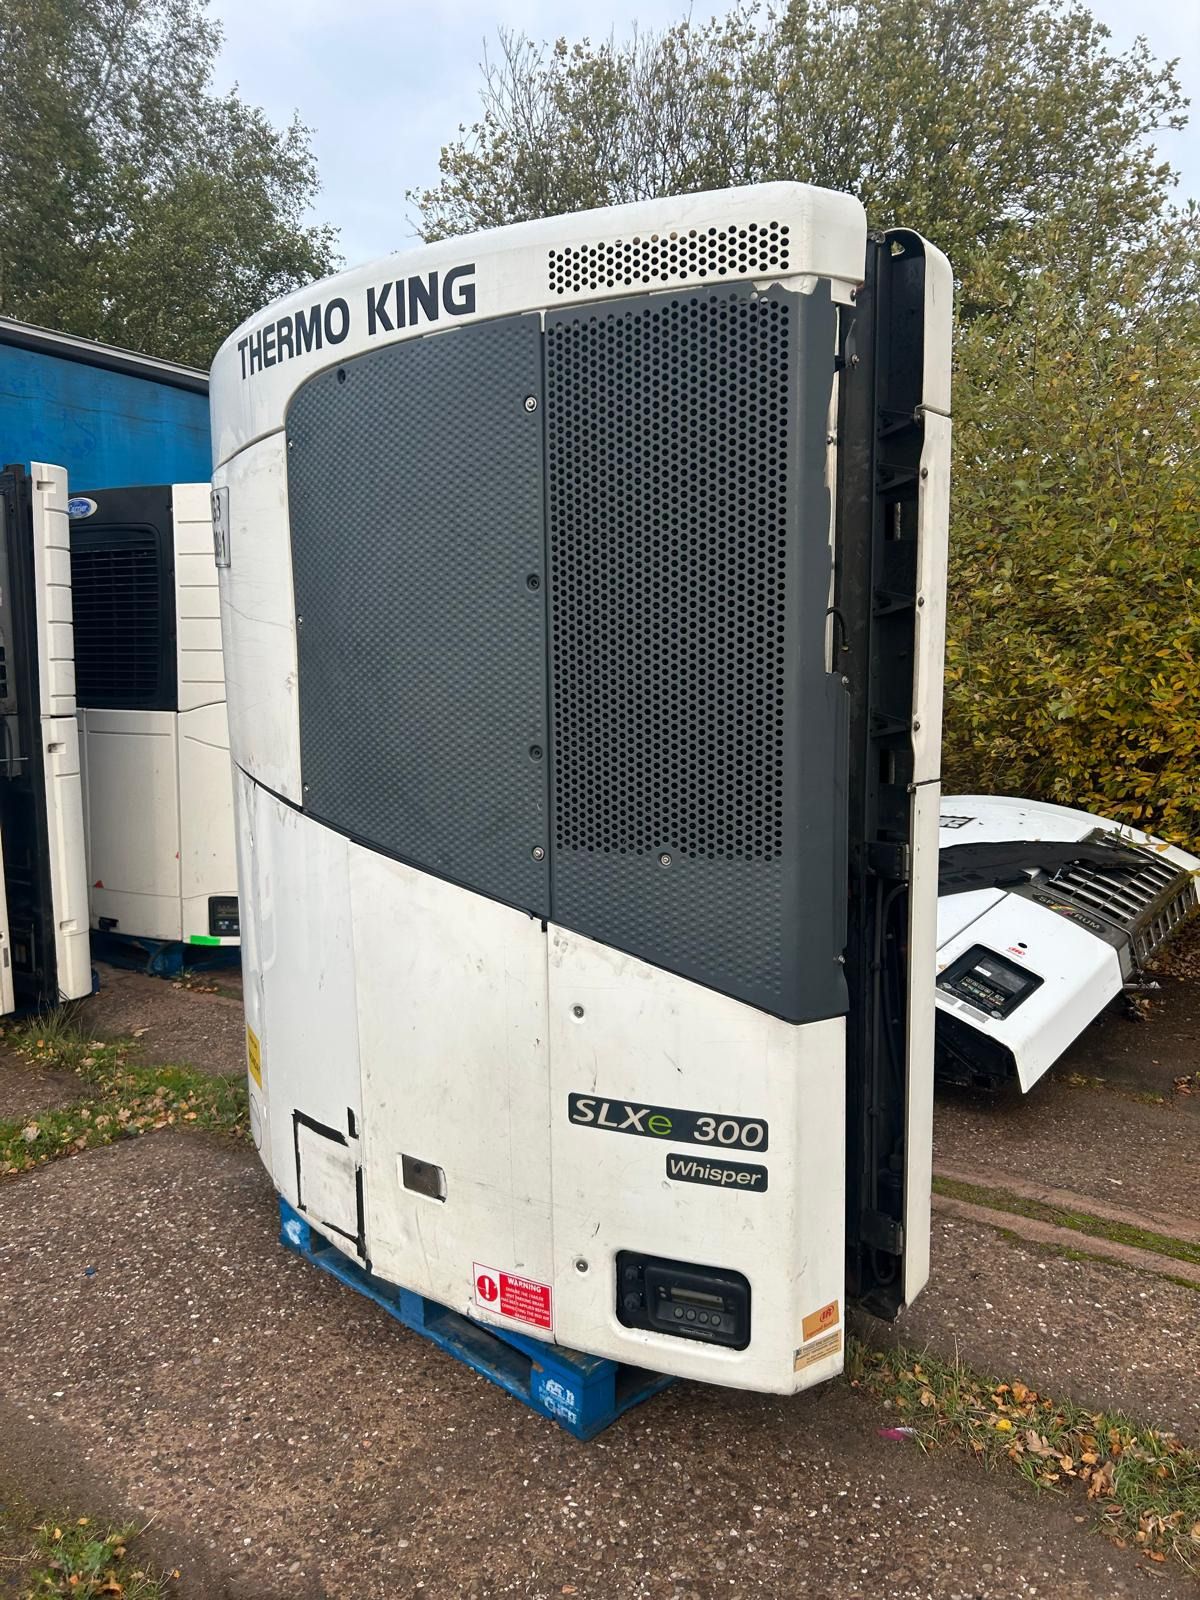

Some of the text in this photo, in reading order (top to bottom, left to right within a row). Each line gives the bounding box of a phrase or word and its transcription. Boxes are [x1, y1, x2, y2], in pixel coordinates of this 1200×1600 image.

[237, 263, 476, 380] THERMO KING
[1038, 895, 1102, 930] SPRUM
[573, 1099, 764, 1147] SLXe 300
[670, 1159, 762, 1185] Whisper
[507, 1277, 541, 1293] WARNING
